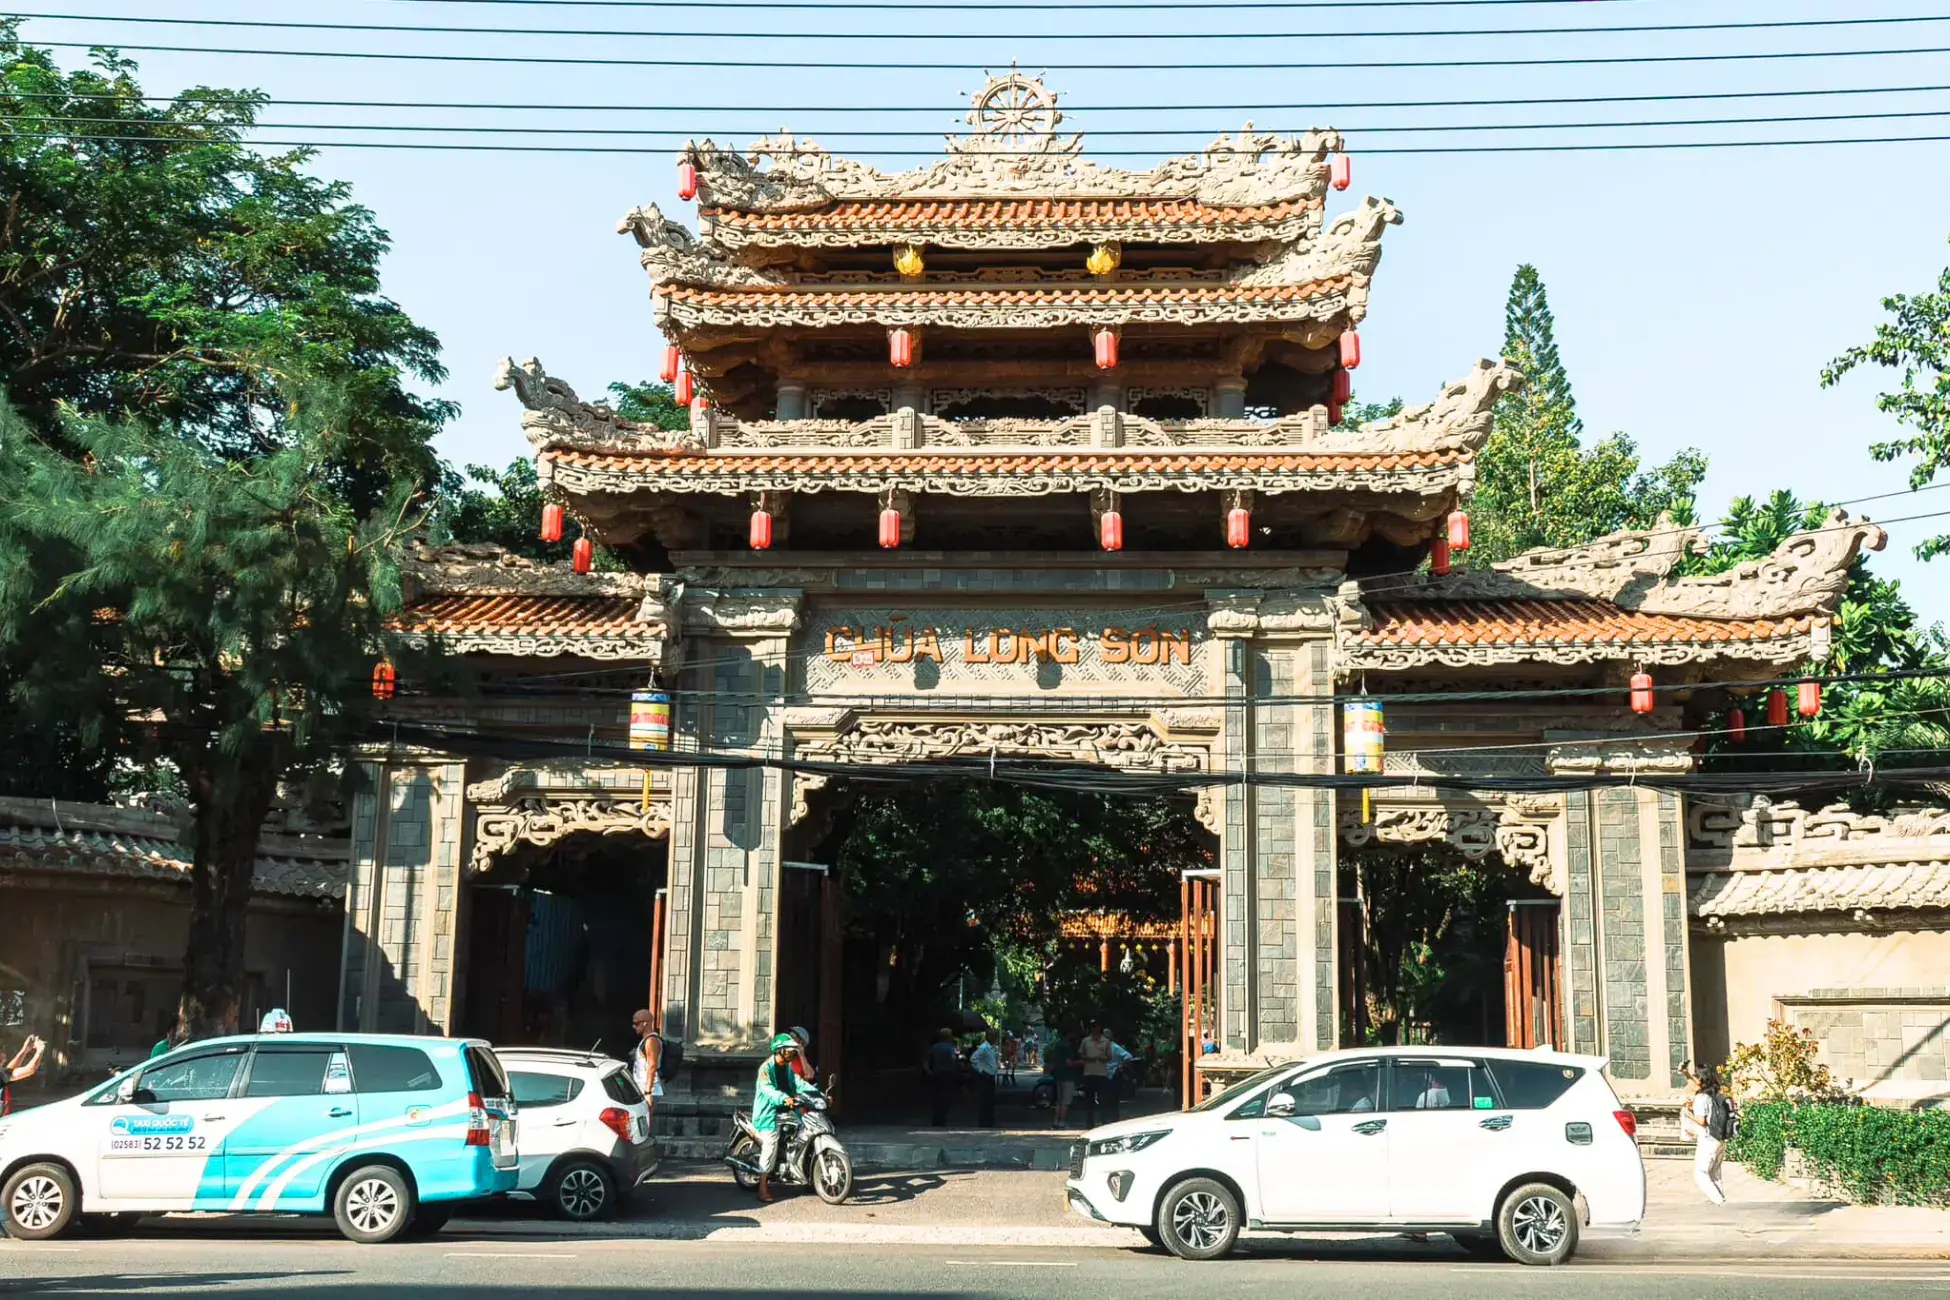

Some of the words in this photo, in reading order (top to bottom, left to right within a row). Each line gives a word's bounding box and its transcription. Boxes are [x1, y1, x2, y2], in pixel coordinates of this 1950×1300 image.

[963, 626, 1080, 664] LONG
[111, 1140, 142, 1150] (02583)
[143, 1137, 161, 1150] 52
[165, 1137, 184, 1150] 52
[188, 1136, 206, 1149] 52
